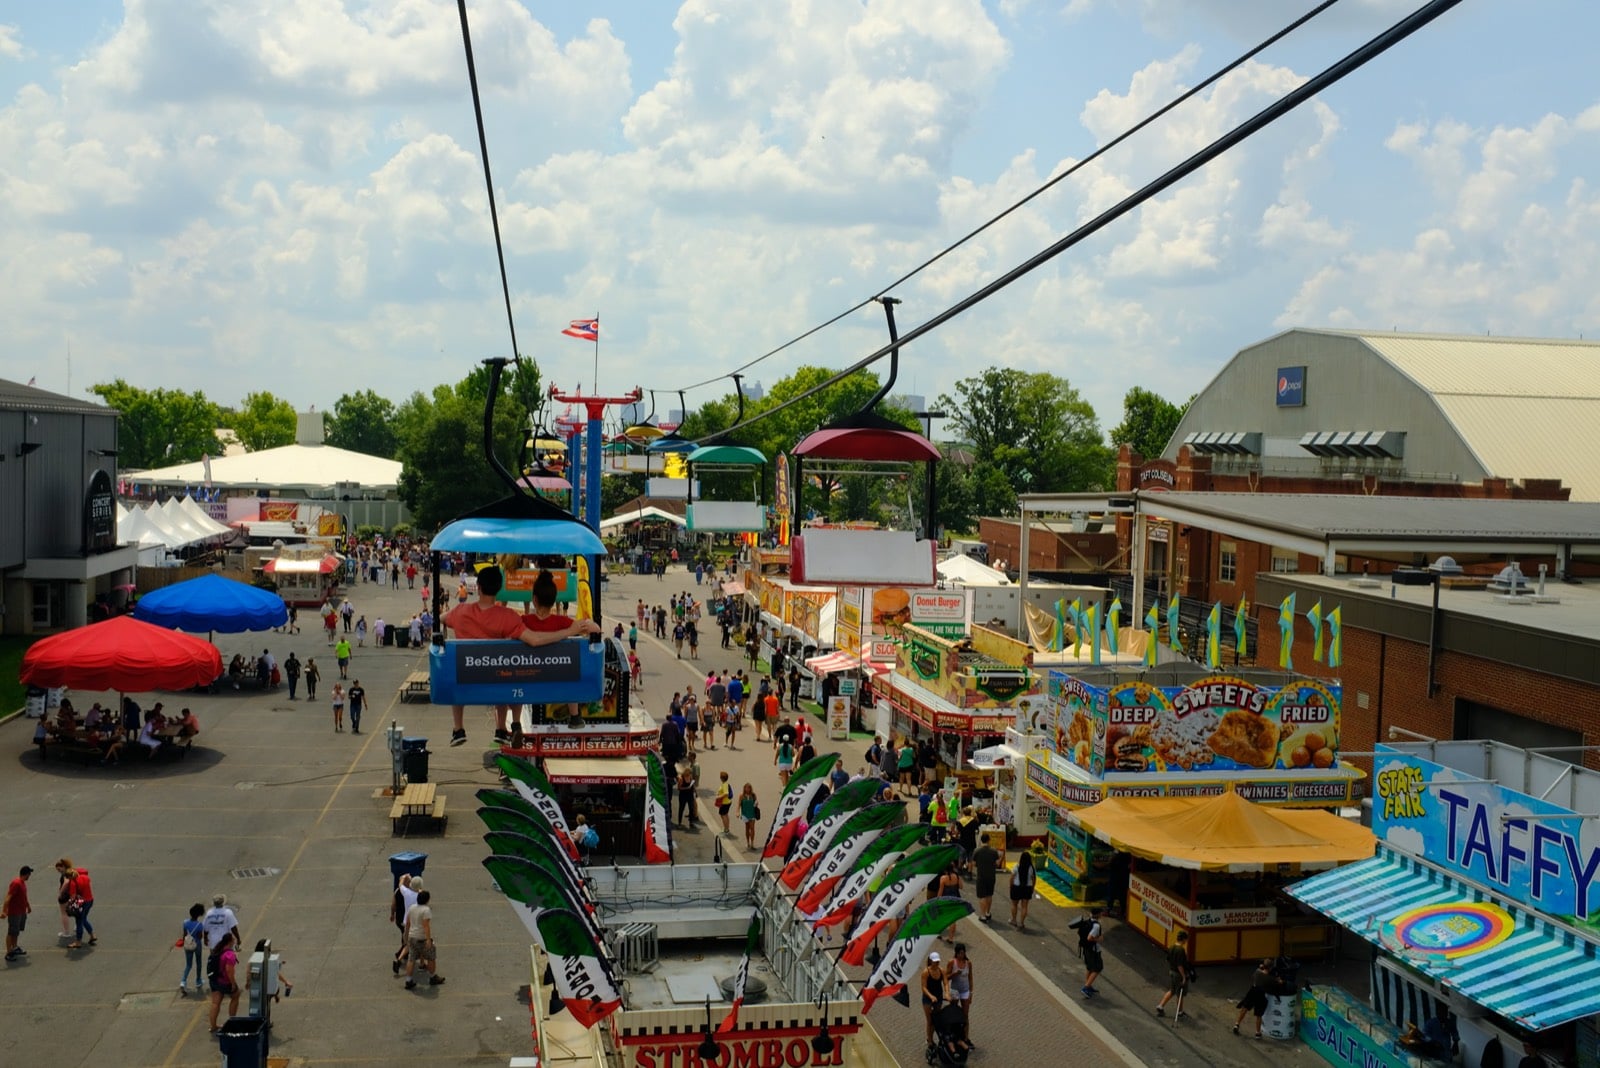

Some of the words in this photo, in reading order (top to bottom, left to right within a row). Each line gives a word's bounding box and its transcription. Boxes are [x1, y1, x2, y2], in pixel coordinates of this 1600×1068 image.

[1140, 469, 1151, 482] TAFT
[1151, 469, 1173, 486] COLISEUM
[92, 496, 111, 508] CONCERT
[210, 504, 228, 512] FUNNE
[92, 506, 112, 518] SERIES
[916, 596, 937, 607] Donut
[938, 596, 961, 609] Burger
[934, 626, 944, 634] ARE
[945, 626, 954, 634] THE
[875, 643, 897, 655] SLOP
[465, 654, 572, 667] BeSafeOhio.com
[512, 688, 524, 698] 75
[1064, 680, 1089, 704] SWEETS
[1174, 684, 1266, 717] SWEETS
[1111, 707, 1155, 723] DEEP
[1282, 706, 1328, 722] FRIED
[974, 723, 994, 731] BOWL
[542, 741, 580, 750] STEAK
[586, 741, 624, 749] STEAK
[1378, 767, 1426, 798] STATE
[1062, 784, 1101, 803] TWINKIES
[1235, 785, 1288, 799] TWINKIES
[1293, 785, 1346, 798] CHEESECAKE
[1383, 792, 1426, 820] FAIR
[1439, 788, 1600, 920] TAFFY
[1131, 879, 1142, 893] BIG
[1142, 886, 1160, 905] JEFF'S
[1160, 900, 1188, 922] ORIGINAL
[1197, 913, 1211, 921] ICE
[1199, 917, 1221, 925] COLD
[1223, 911, 1270, 919] LEMONADE
[1316, 1015, 1358, 1064] SALT
[635, 1036, 844, 1068] STROMBOLI
